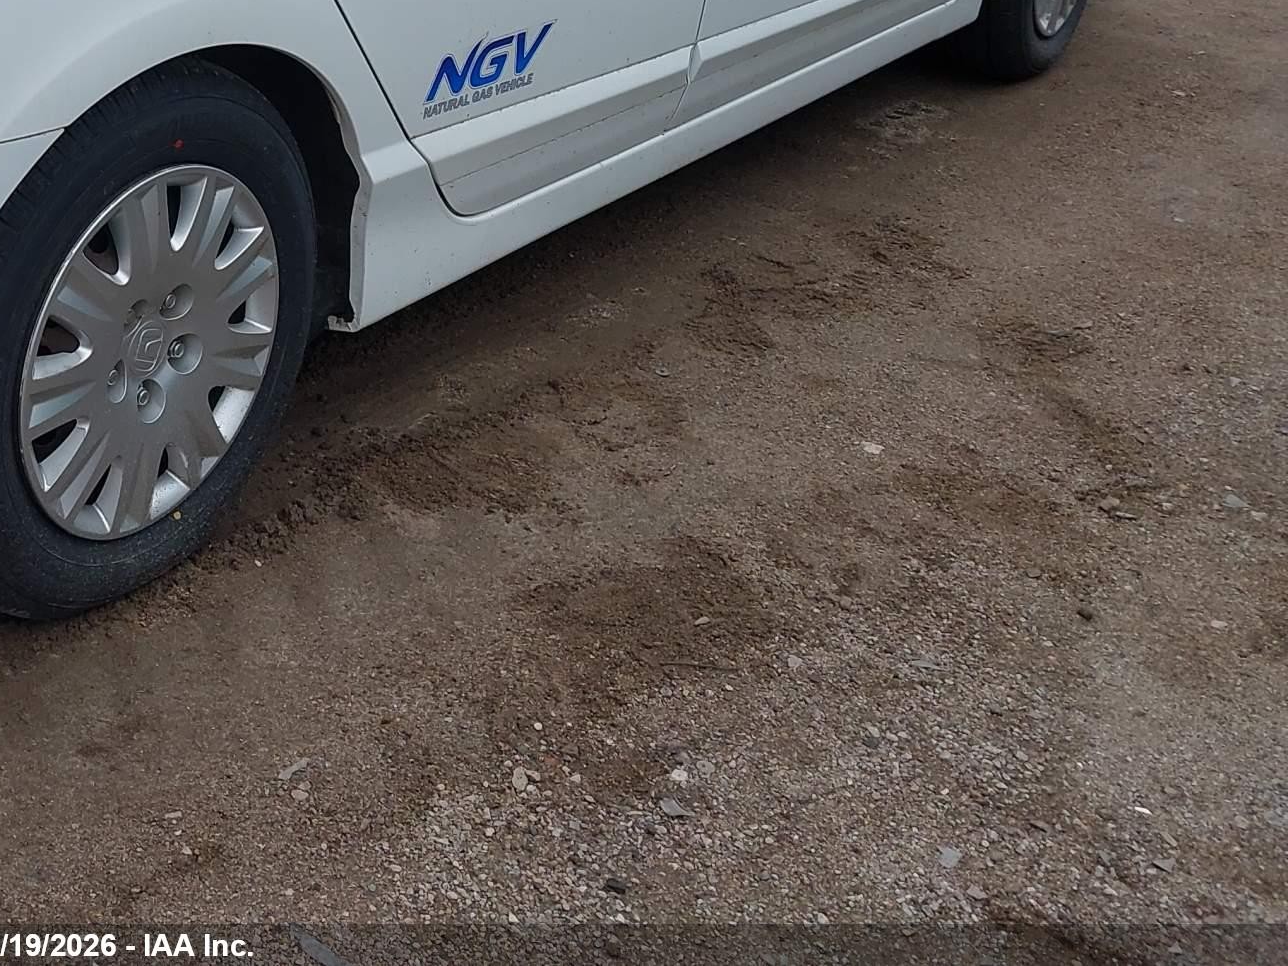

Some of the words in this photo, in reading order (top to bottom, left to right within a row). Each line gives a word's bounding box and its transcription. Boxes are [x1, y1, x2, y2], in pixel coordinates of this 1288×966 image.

[424, 20, 556, 104] NGV
[422, 95, 471, 120] NATURAL
[472, 86, 494, 104] GAS
[495, 73, 535, 96] VEHICLE
